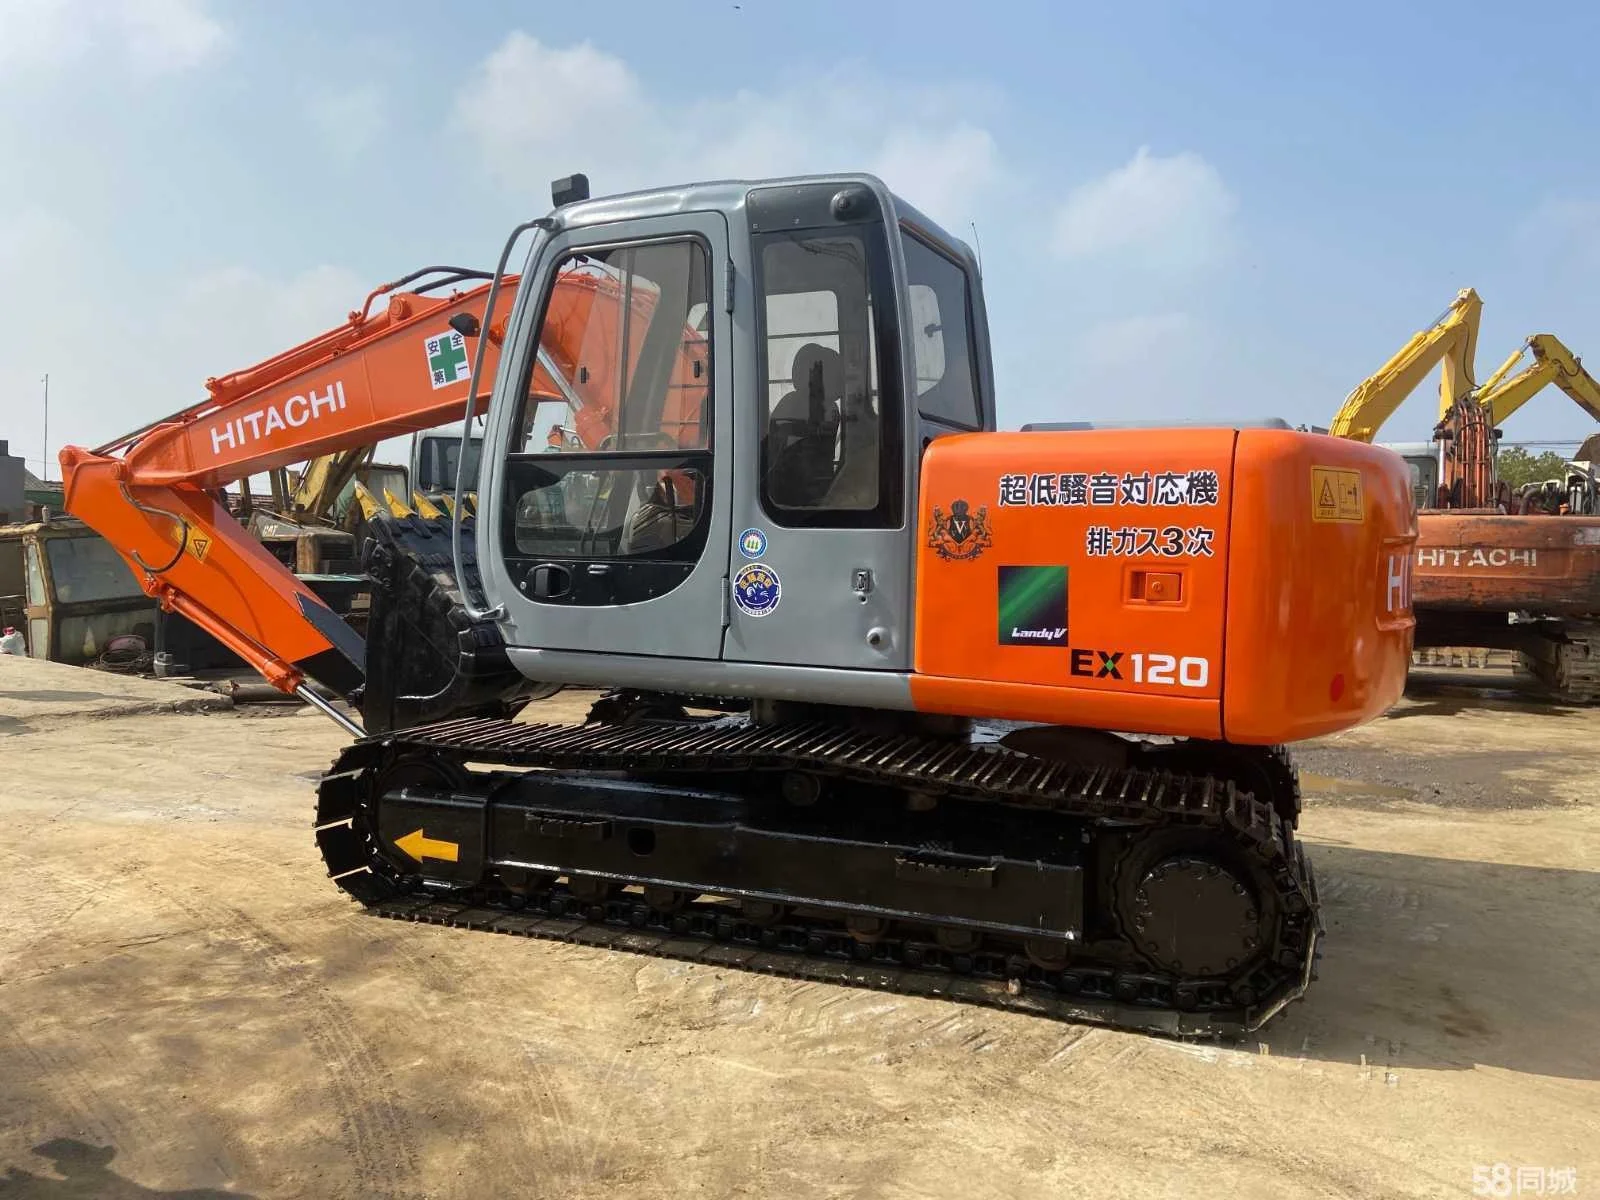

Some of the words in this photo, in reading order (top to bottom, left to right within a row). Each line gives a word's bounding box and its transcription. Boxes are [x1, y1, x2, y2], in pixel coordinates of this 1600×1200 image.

[210, 381, 346, 455] HITACHI
[999, 470, 1219, 507] 超低騒音対応機
[1086, 526, 1214, 556] 排ガス3次
[1417, 548, 1537, 567] HITACHI
